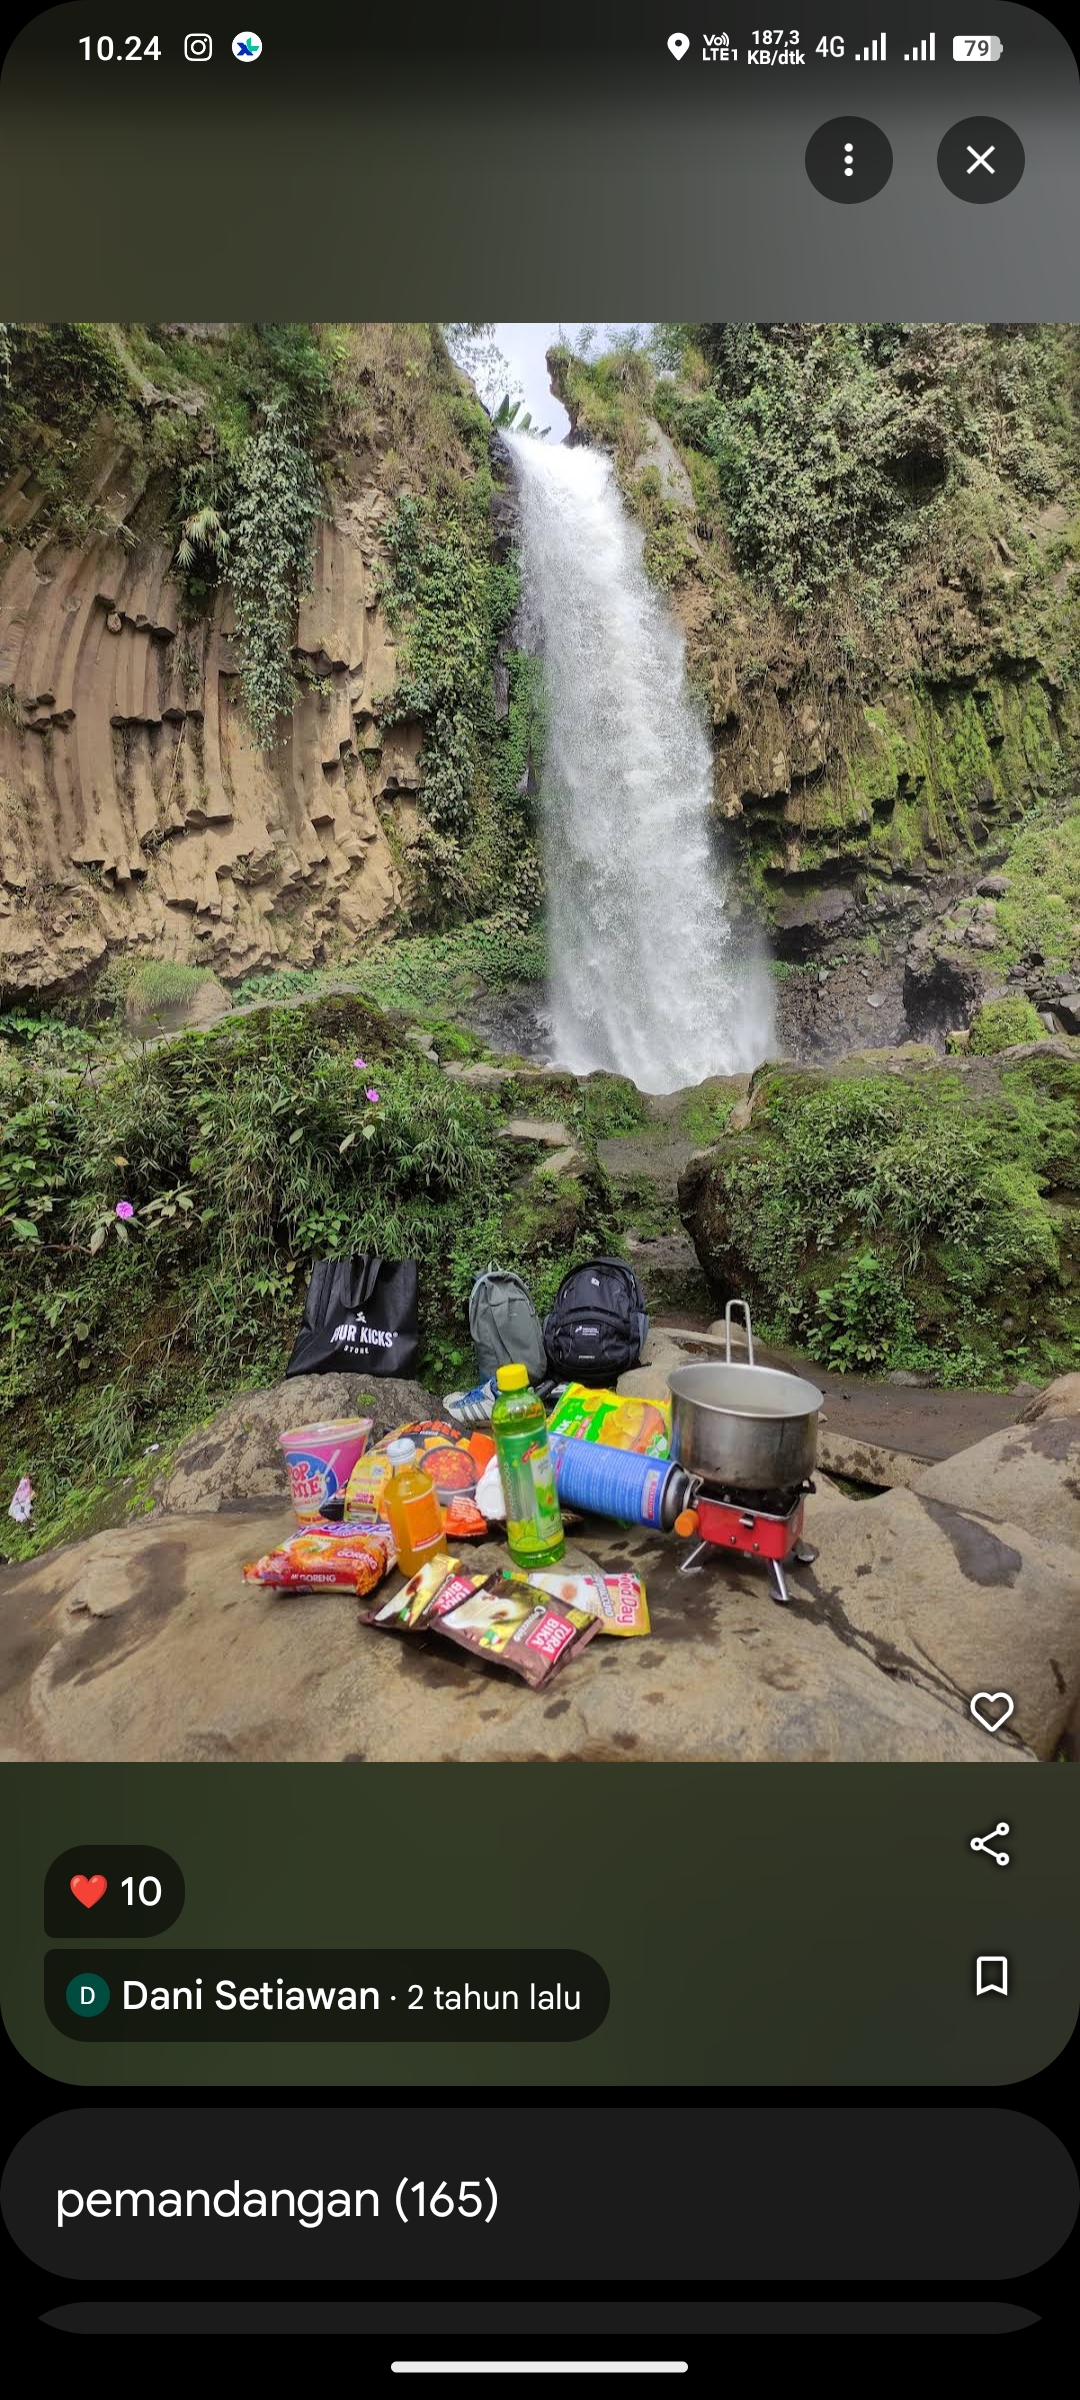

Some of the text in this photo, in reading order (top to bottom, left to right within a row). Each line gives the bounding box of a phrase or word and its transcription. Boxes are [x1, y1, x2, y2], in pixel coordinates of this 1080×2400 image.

[291, 1476, 322, 1498] MIE
[336, 1550, 378, 1571] GORENG
[299, 1573, 337, 1583] GORENG
[530, 1617, 560, 1645] BIKA
[542, 1624, 572, 1654] TORA
